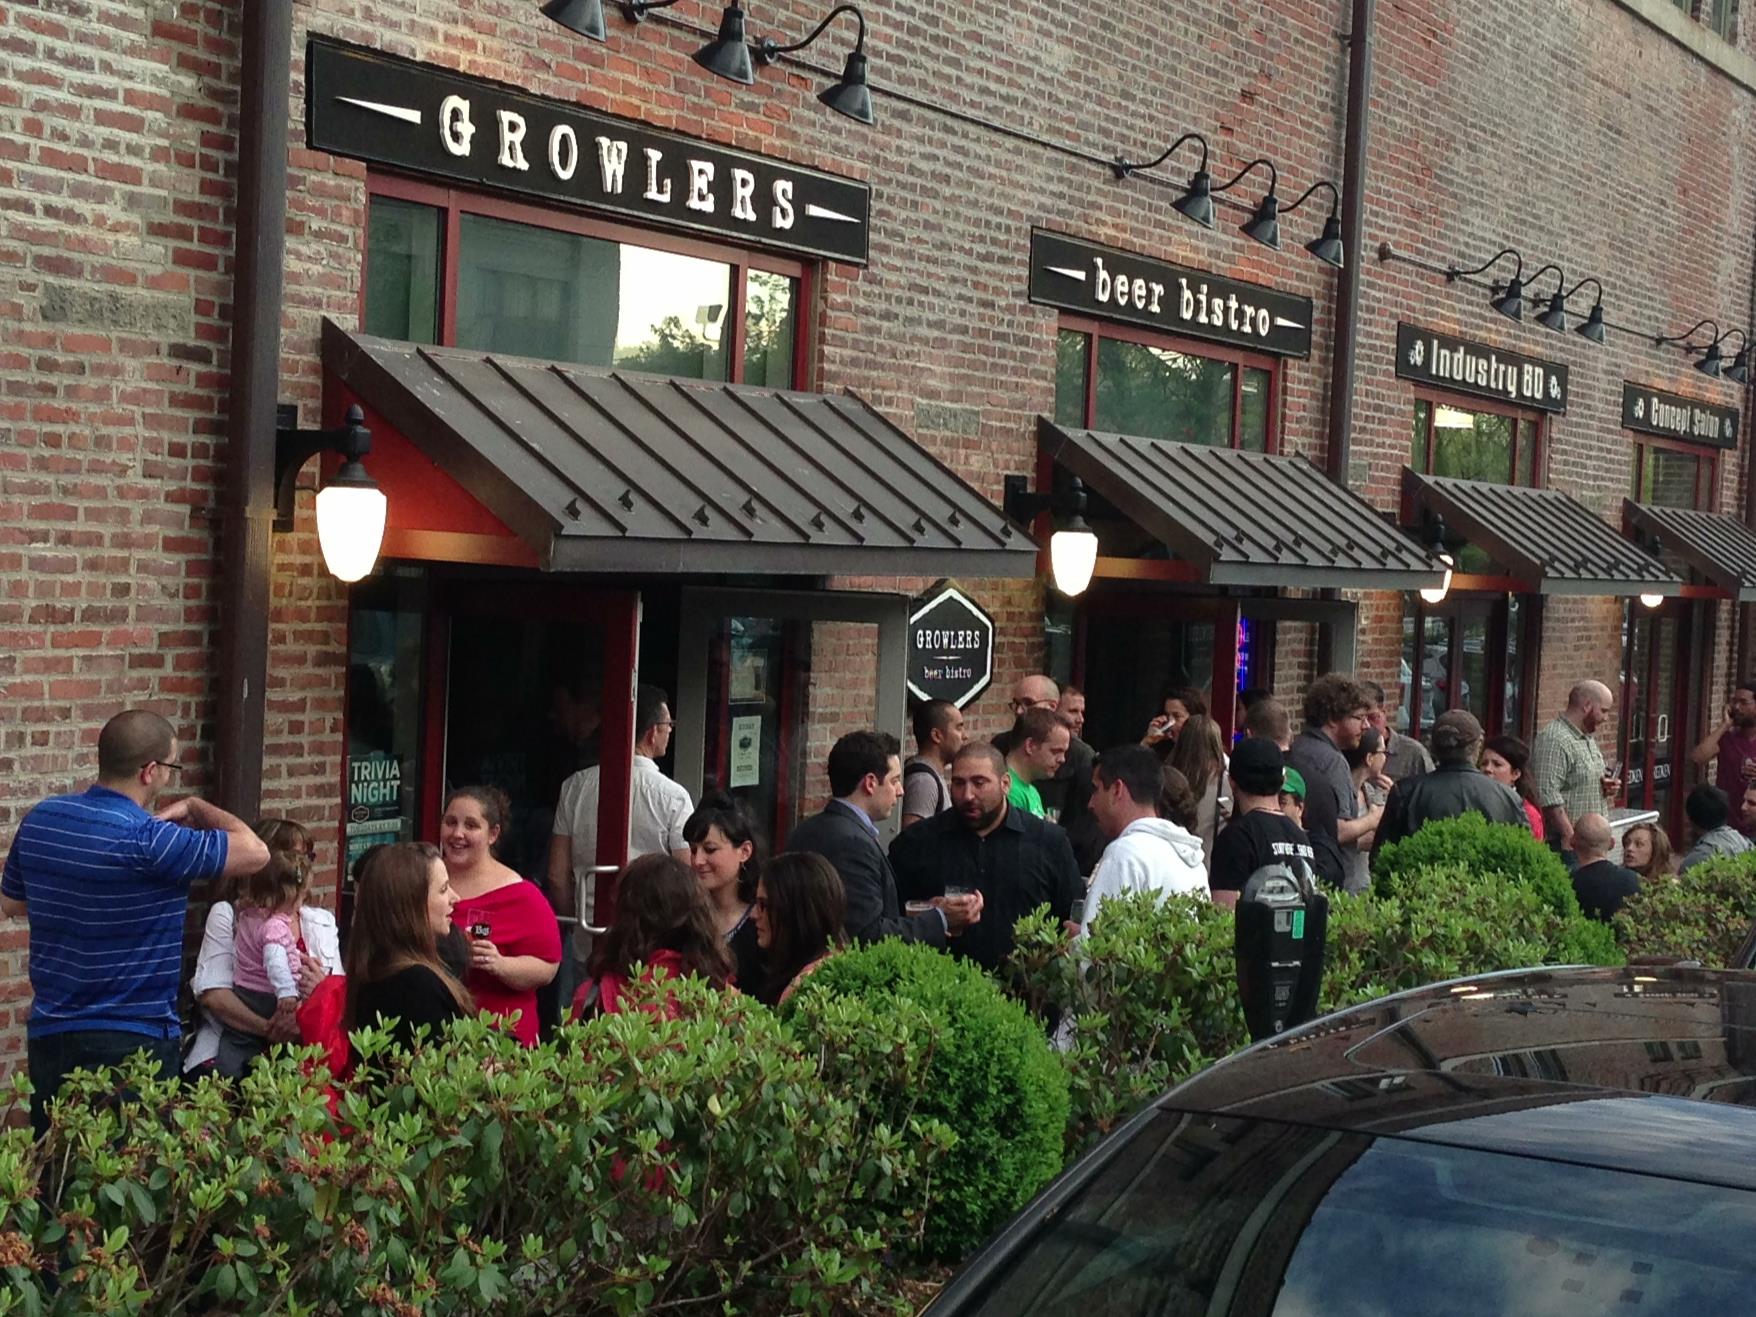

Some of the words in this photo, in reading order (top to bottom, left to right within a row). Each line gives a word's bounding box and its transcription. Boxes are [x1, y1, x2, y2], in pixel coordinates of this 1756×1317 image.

[440, 95, 794, 229] GROWLERS
[1093, 257, 1164, 313] beer
[1178, 278, 1270, 336] bistro
[1431, 339, 1518, 398] Industry
[1651, 397, 1691, 435] Concept
[917, 629, 980, 649] GROWLERS
[924, 666, 942, 679] beer
[945, 665, 972, 679] bistro
[352, 760, 400, 781] TRIVIA
